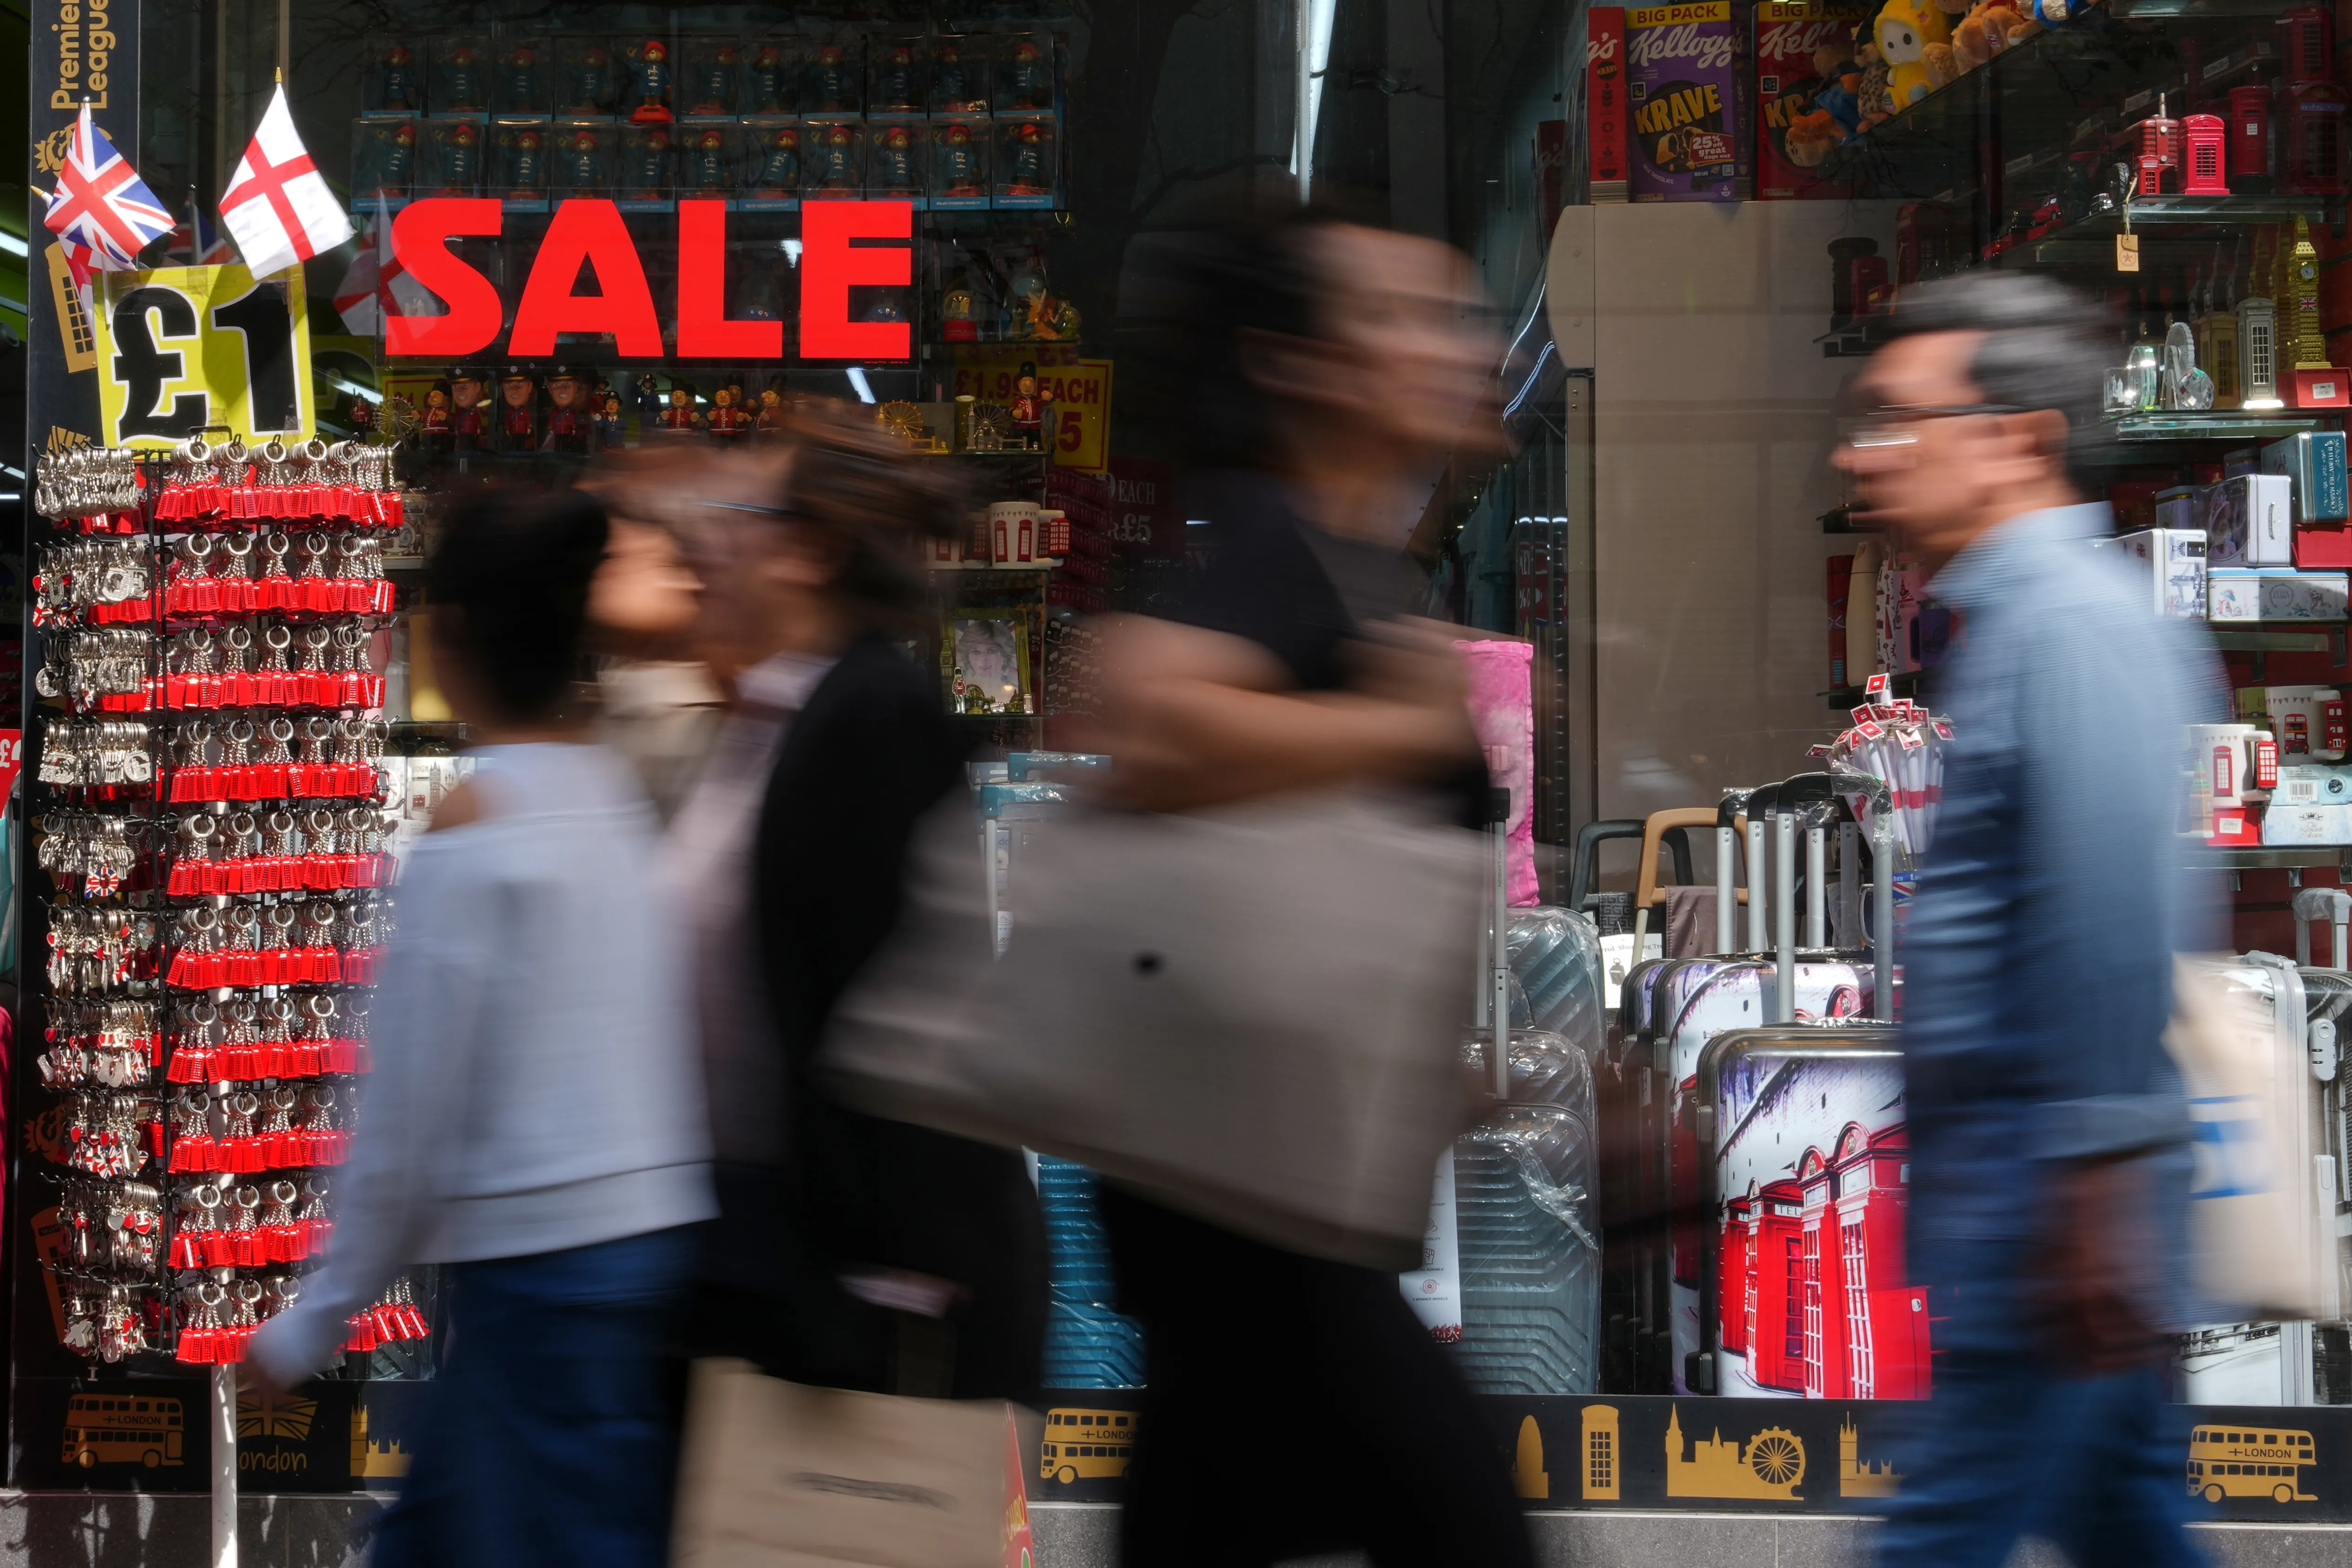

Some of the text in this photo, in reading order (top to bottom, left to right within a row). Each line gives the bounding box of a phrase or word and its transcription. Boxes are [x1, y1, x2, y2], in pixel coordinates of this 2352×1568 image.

[1637, 4, 1718, 24] BIG PACK
[1771, 5, 1803, 17] BIG
[1634, 84, 1723, 134] KRAVE
[1698, 147, 1726, 157] great
[385, 198, 912, 358] SALE
[112, 282, 304, 445] £1
[1037, 376, 1099, 404] EACH
[1118, 479, 1156, 505] EACH
[118, 1415, 161, 1426] LONDON
[1097, 1430, 1134, 1440] LONDO
[237, 1445, 307, 1474] ondon
[2245, 1448, 2292, 1458] LONDON
